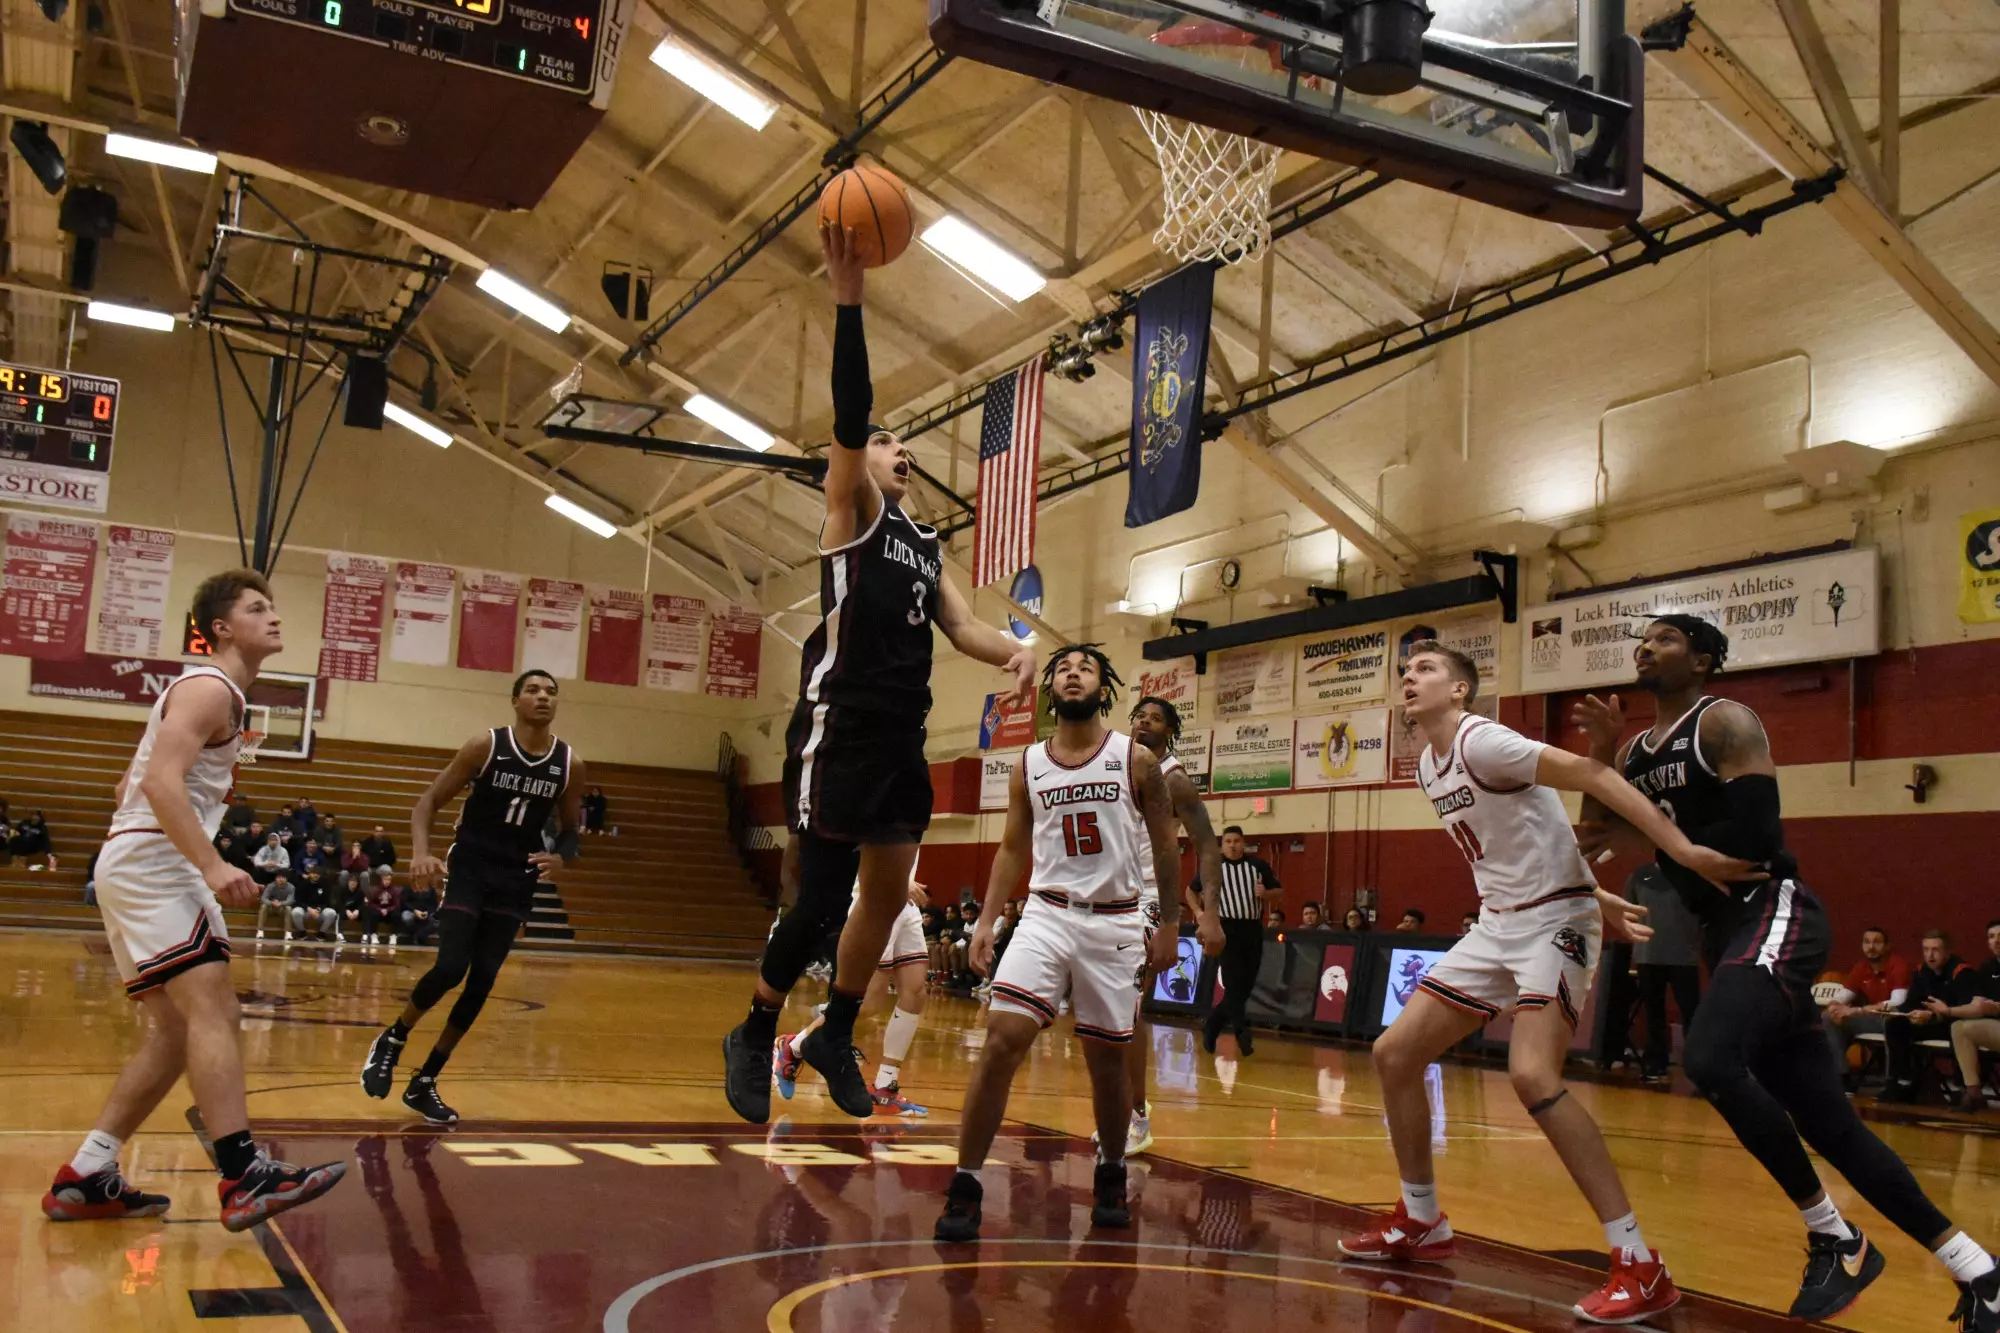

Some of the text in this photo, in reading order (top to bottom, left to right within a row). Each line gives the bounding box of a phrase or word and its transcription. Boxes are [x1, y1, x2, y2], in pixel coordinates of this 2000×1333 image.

[324, 0, 342, 26] 0
[372, 0, 415, 17] FOULS
[508, 3, 572, 29] TIMEOUTS
[426, 11, 475, 32] PLAYER
[521, 18, 554, 36] LEFT
[574, 17, 590, 40] 4
[392, 40, 446, 63] TIME ADV
[518, 49, 527, 71] 1
[539, 53, 575, 72] TEAM
[534, 65, 575, 83] FOULS
[71, 378, 117, 395] VISITOR
[36, 404, 45, 423] 1
[93, 395, 112, 420] 0
[88, 443, 97, 462] 1
[0, 474, 98, 502] STORE
[38, 519, 97, 539] WRESTLING
[883, 534, 918, 570] LOCK
[906, 580, 928, 626] 3
[1575, 575, 1794, 623] Lock Haven University Athletics
[1723, 596, 1799, 627] TROPHY
[1570, 623, 1633, 648] WINNER
[1741, 624, 1785, 641] 2001-02
[1303, 632, 1386, 660] SUSQUEHANNA
[1532, 637, 1561, 652] LOCK
[1586, 647, 1623, 662] 2000-01
[111, 659, 145, 678] The
[1337, 655, 1383, 673] TRAILWAYS
[1586, 658, 1624, 672] 2006-07
[31, 683, 126, 701] @HavenAthletics
[1139, 668, 1179, 700] TEXAS
[1318, 686, 1362, 700] 800-692-6314
[1216, 738, 1291, 754] BERKEBILE REAL ESTATE
[1353, 738, 1382, 751] #4298
[492, 770, 558, 799] LOCK HAVEN
[1040, 783, 1119, 809] VULCANS
[504, 797, 531, 827] 11
[1062, 811, 1103, 857] 15
